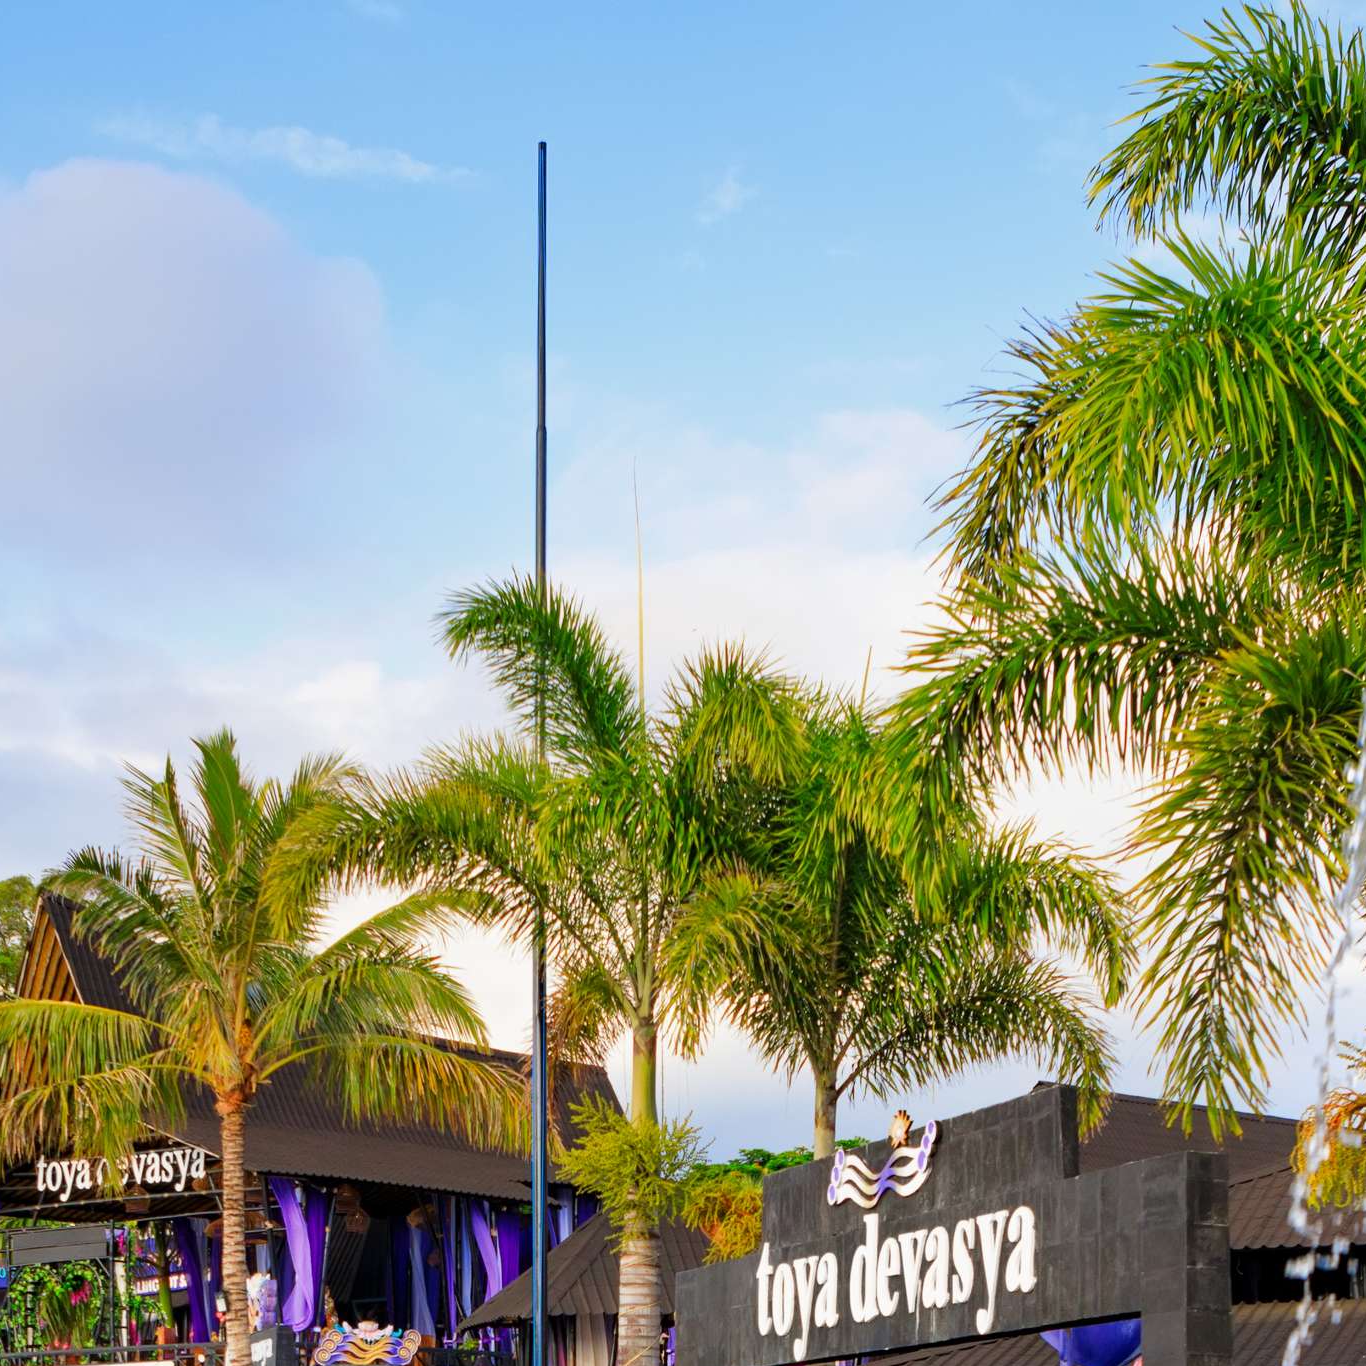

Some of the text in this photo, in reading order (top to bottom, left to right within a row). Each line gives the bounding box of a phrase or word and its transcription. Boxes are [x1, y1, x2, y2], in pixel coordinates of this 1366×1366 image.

[36, 1155, 92, 1202] toya
[756, 1205, 1037, 1362] toya devasya
